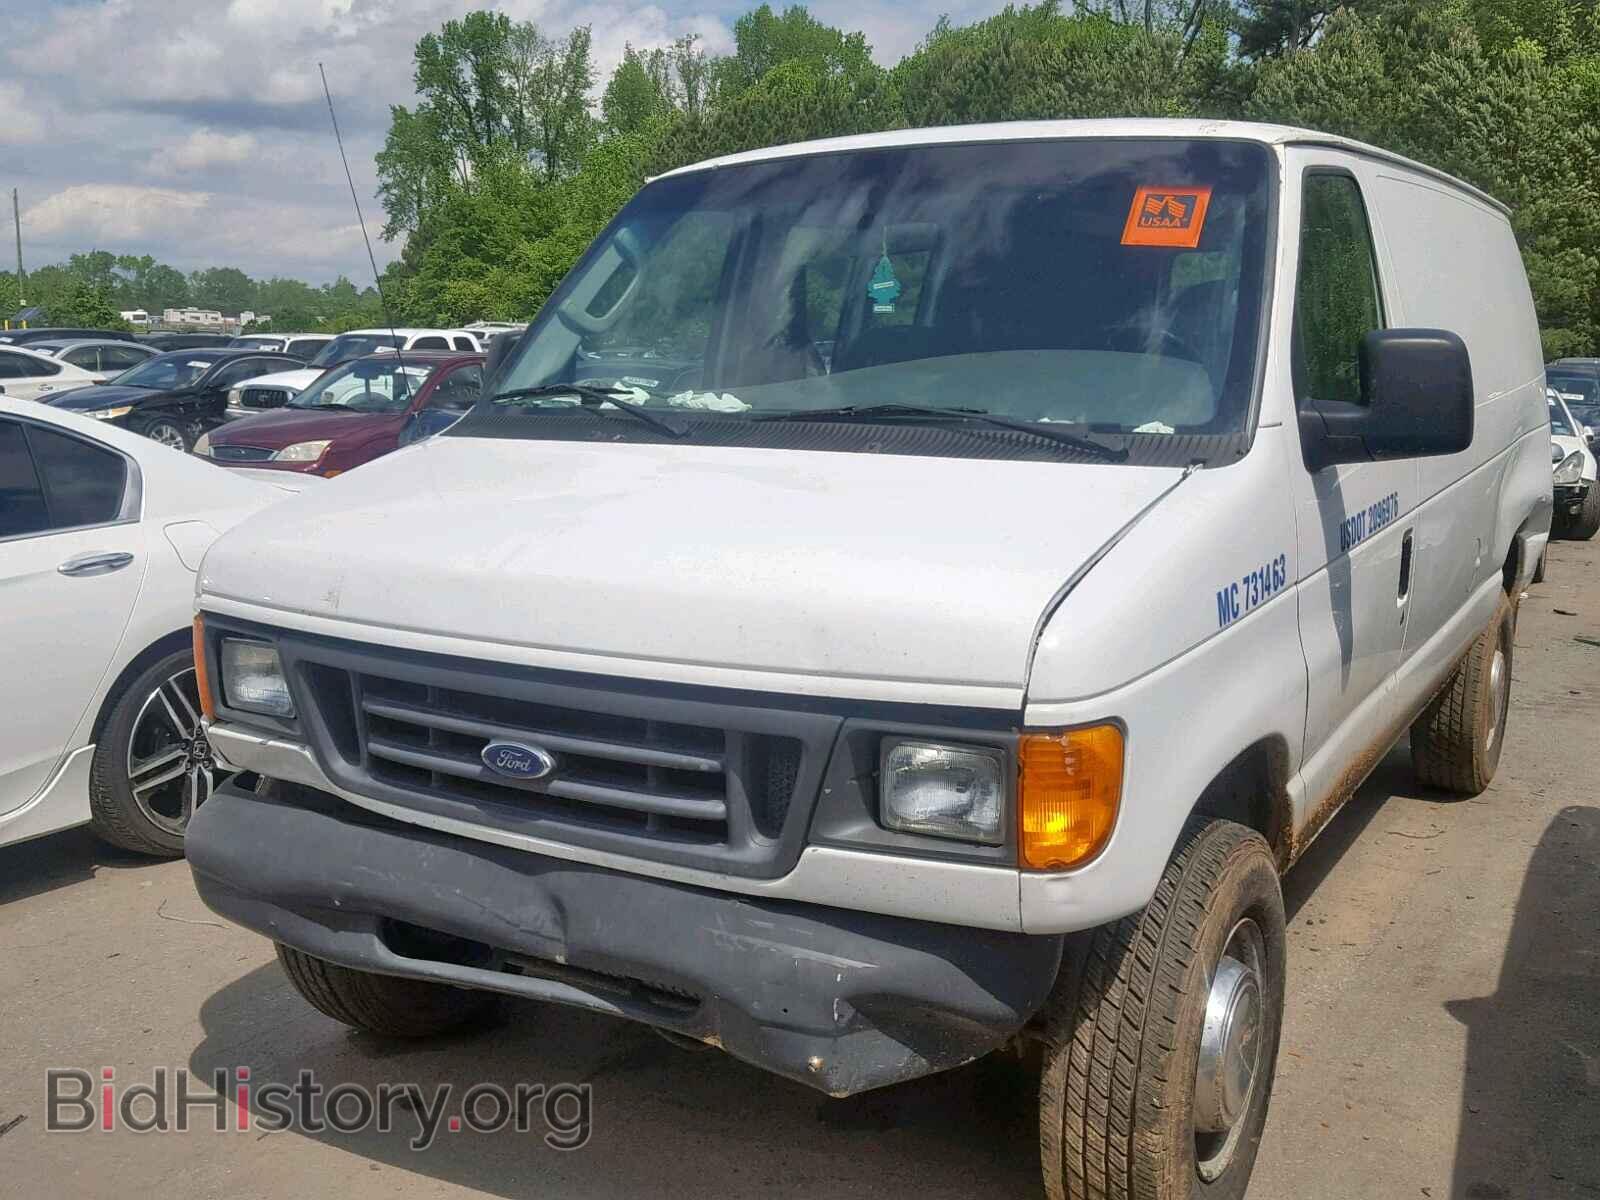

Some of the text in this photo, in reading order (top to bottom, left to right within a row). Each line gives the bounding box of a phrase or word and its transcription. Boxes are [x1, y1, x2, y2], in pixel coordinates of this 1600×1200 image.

[1339, 492, 1399, 552] USDOT 2096976
[1216, 553, 1286, 627] MC 731463
[496, 749, 531, 772] Ford
